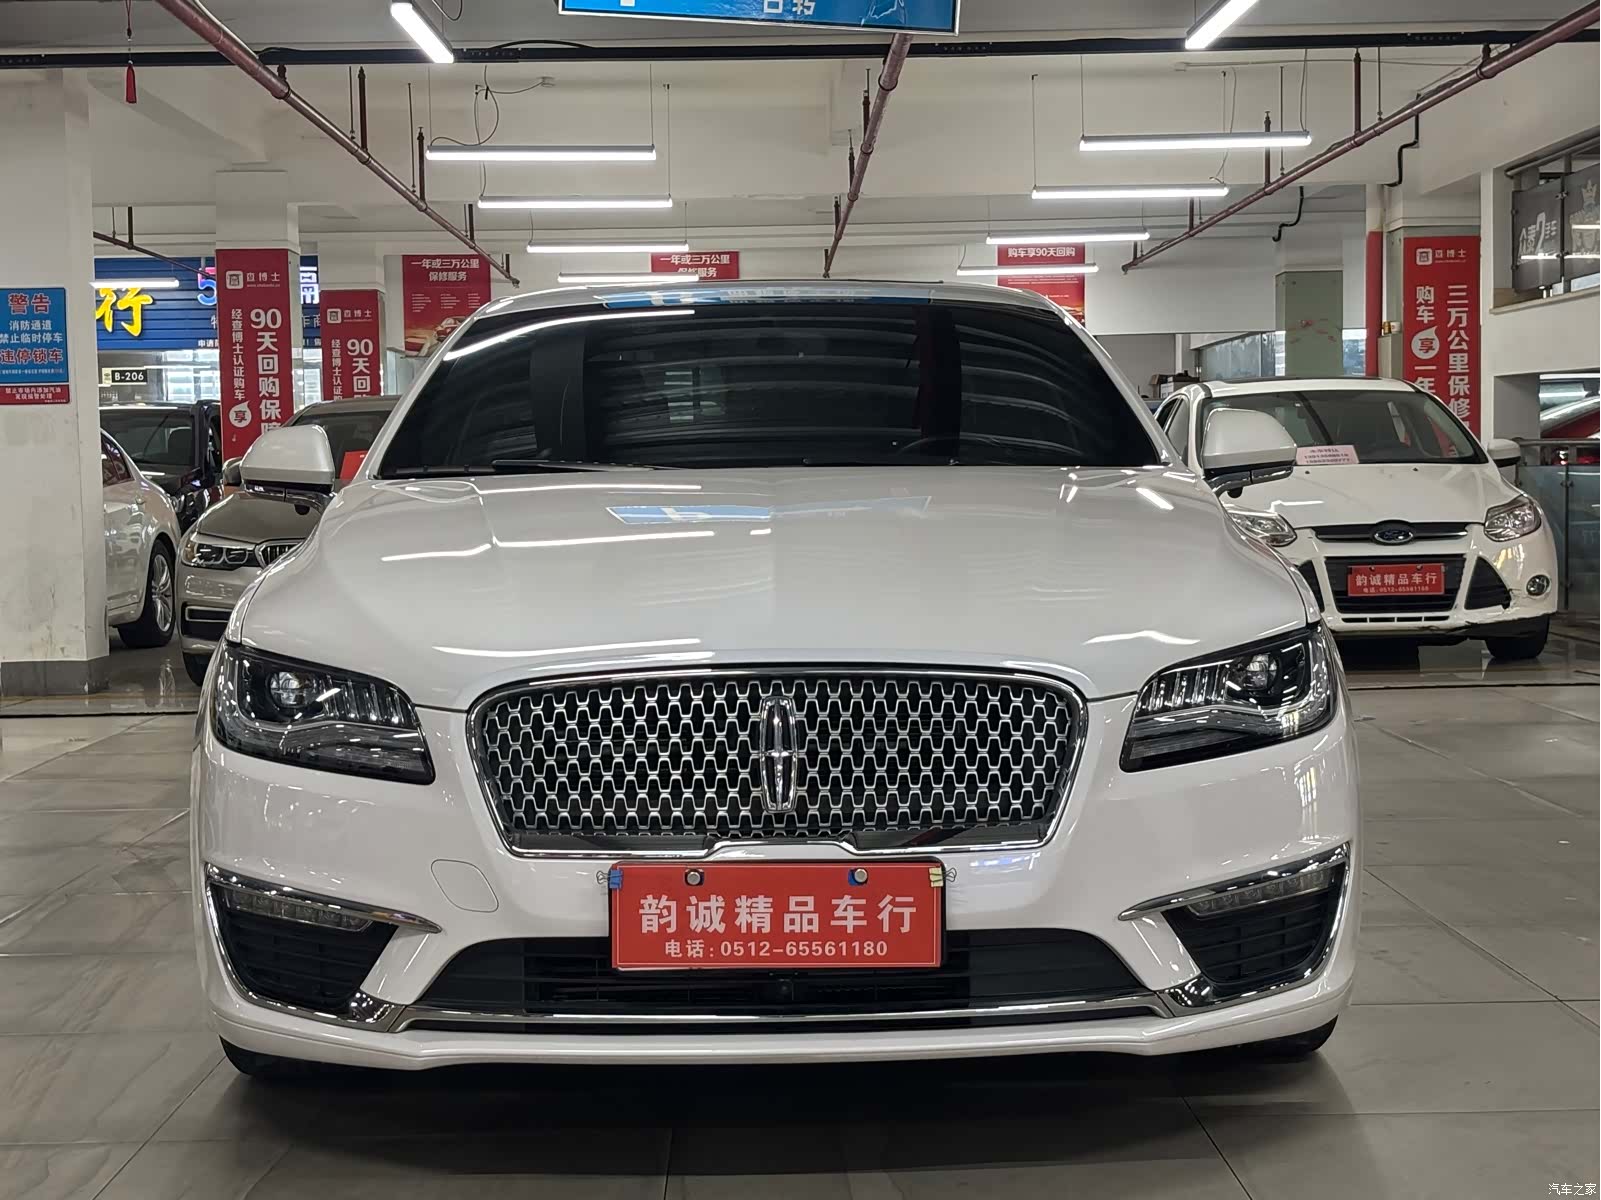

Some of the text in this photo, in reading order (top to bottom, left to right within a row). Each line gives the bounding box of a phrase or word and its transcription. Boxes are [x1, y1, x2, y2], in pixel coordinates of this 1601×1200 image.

[1007, 247, 1076, 258] 购车享90天回购
[411, 258, 479, 269] 一年或三万公里
[660, 254, 730, 265] 一年或三万公里
[246, 272, 280, 282] 查博士
[429, 271, 467, 282] 保修服务
[8, 293, 51, 315] 警告
[1416, 286, 1435, 324] 购车
[9, 320, 52, 331] 消防通道
[0, 333, 64, 344] 禁止临时停车
[1419, 338, 1435, 354] 享
[0, 348, 64, 365] 违停锁车
[231, 308, 246, 401] 经查博士认证购车
[1446, 285, 1470, 428] 三万公里保修
[114, 371, 145, 381] B-206
[233, 410, 248, 423] 享
[1355, 572, 1438, 586] 韵诚精品车行
[639, 895, 916, 933] 韵诚精品车行
